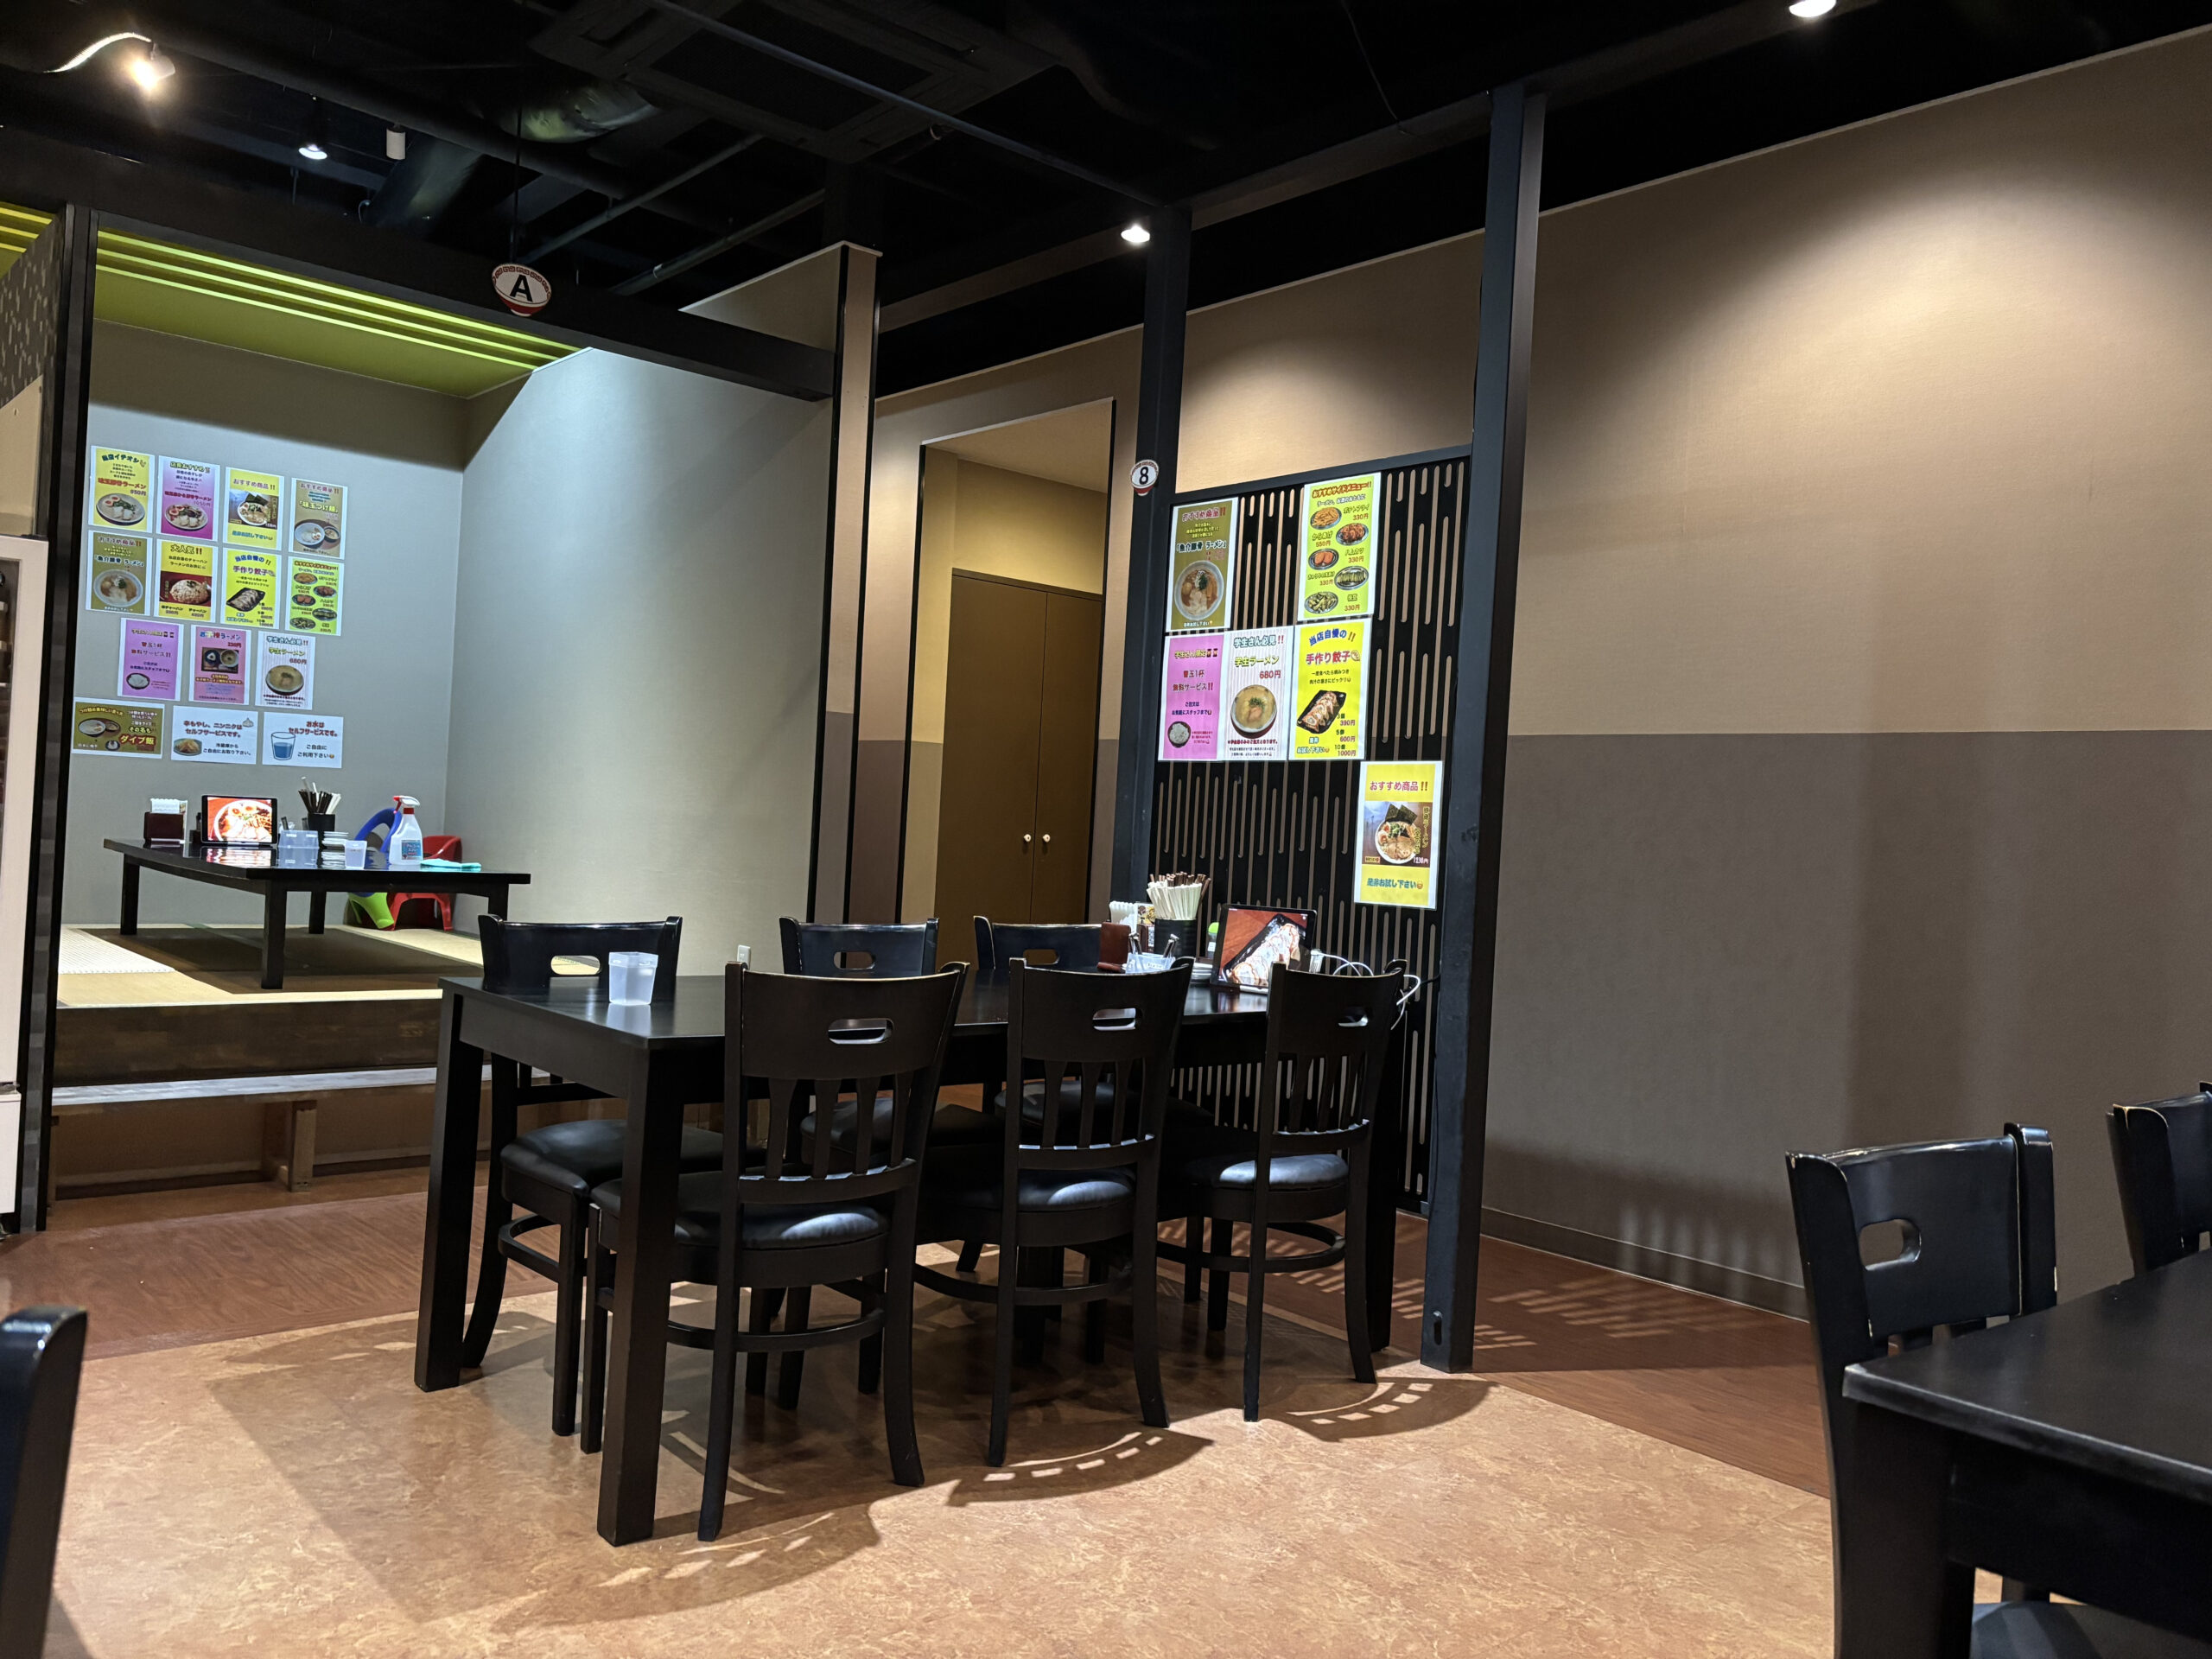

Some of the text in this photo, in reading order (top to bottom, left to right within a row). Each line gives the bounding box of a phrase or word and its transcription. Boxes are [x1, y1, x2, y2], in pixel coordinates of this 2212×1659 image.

[510, 274, 533, 302] A
[1139, 467, 1149, 485] 8
[1352, 512, 1369, 521] 330円
[1235, 656, 1280, 667] 学生ラーメン
[1306, 650, 1351, 665] 手作り餃子
[1259, 670, 1281, 679] 680円
